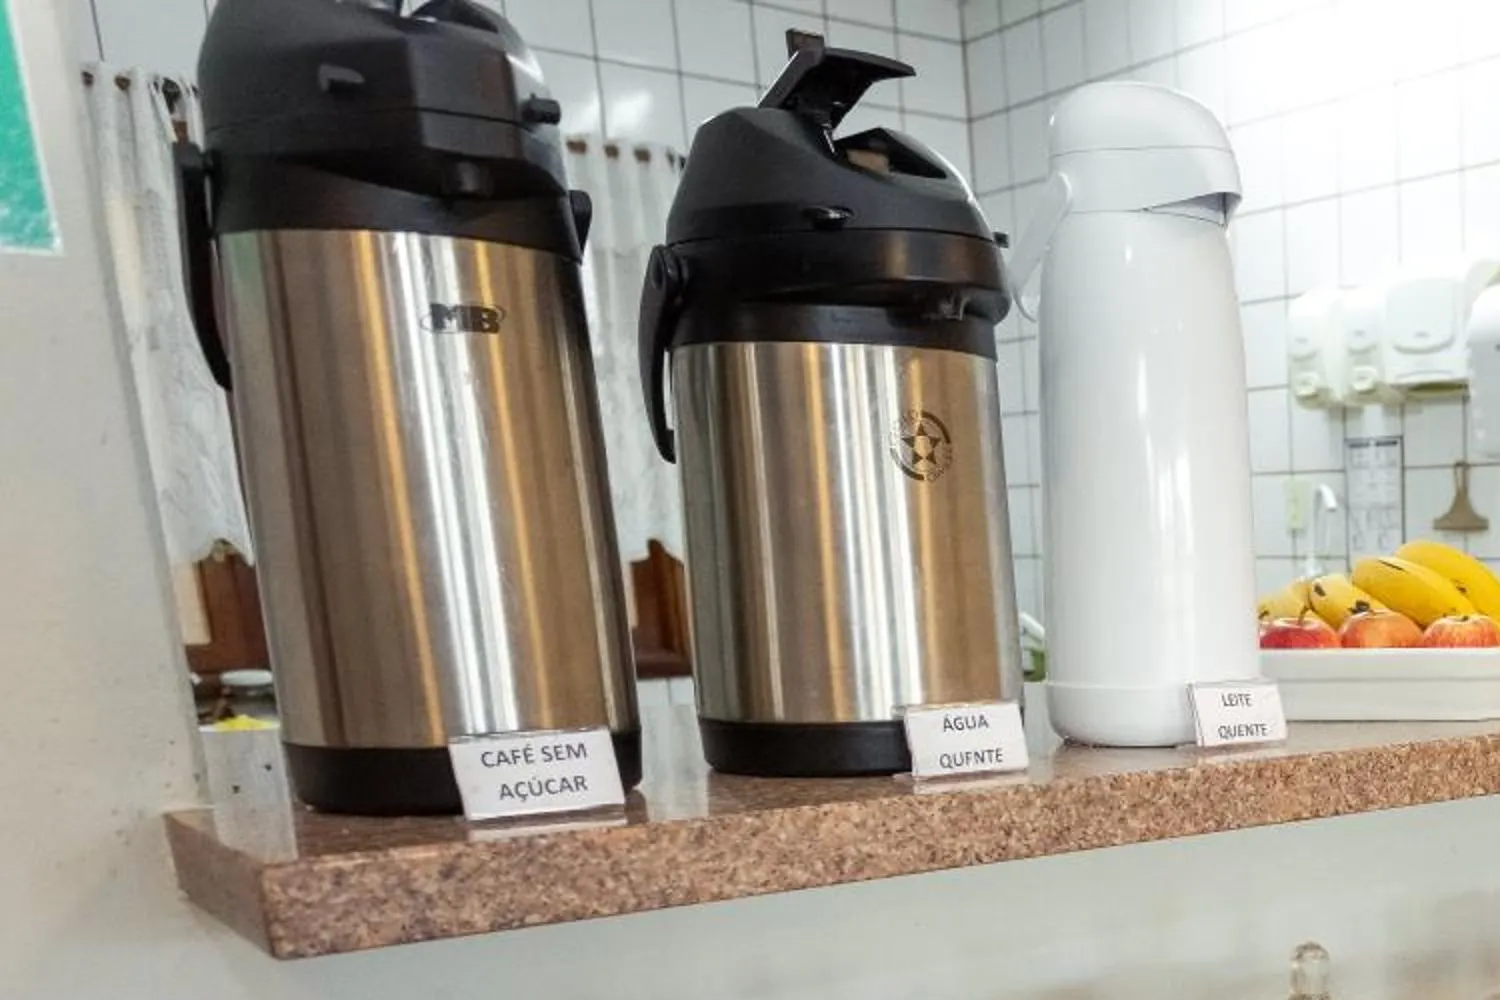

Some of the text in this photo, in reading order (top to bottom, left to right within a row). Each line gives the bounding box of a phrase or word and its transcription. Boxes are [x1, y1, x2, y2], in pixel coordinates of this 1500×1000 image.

[1220, 692, 1253, 708] LEITE
[942, 713, 990, 733] ÁGUA
[1217, 722, 1268, 740] QUENTE
[480, 742, 588, 769] CAFÉ SEM
[939, 747, 1004, 769] QUENTE
[499, 775, 589, 803] AÇÚCAR
